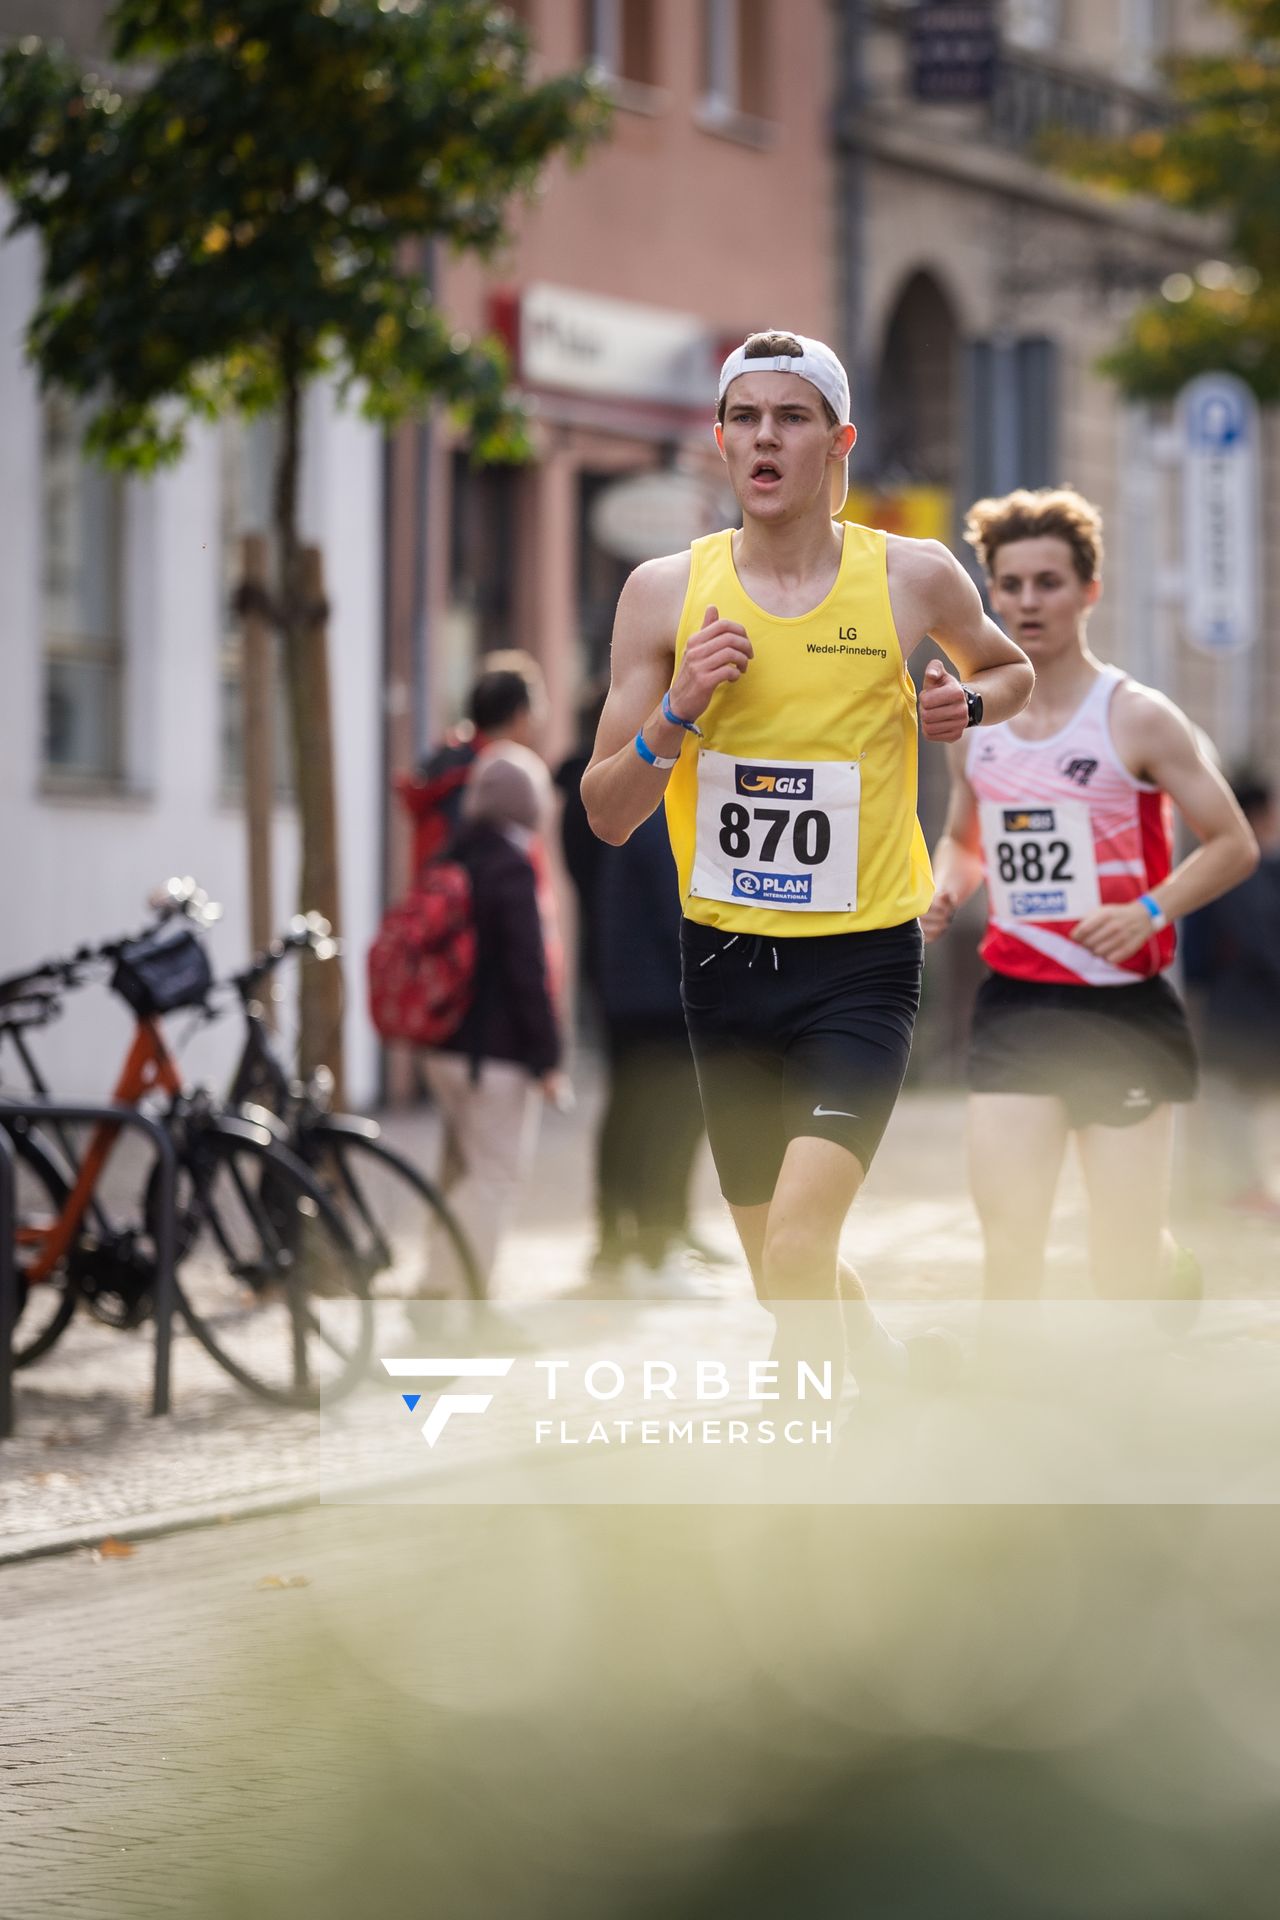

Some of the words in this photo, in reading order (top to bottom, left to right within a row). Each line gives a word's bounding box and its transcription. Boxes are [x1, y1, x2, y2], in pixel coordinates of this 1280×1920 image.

[839, 627, 857, 640] LG
[806, 644, 887, 658] Wedel-Pinneberg
[775, 777, 807, 794] GLS
[719, 802, 831, 865] 870
[998, 842, 1073, 882] 882
[763, 878, 808, 893] PLAN
[763, 892, 807, 900] INTERNATIONAL
